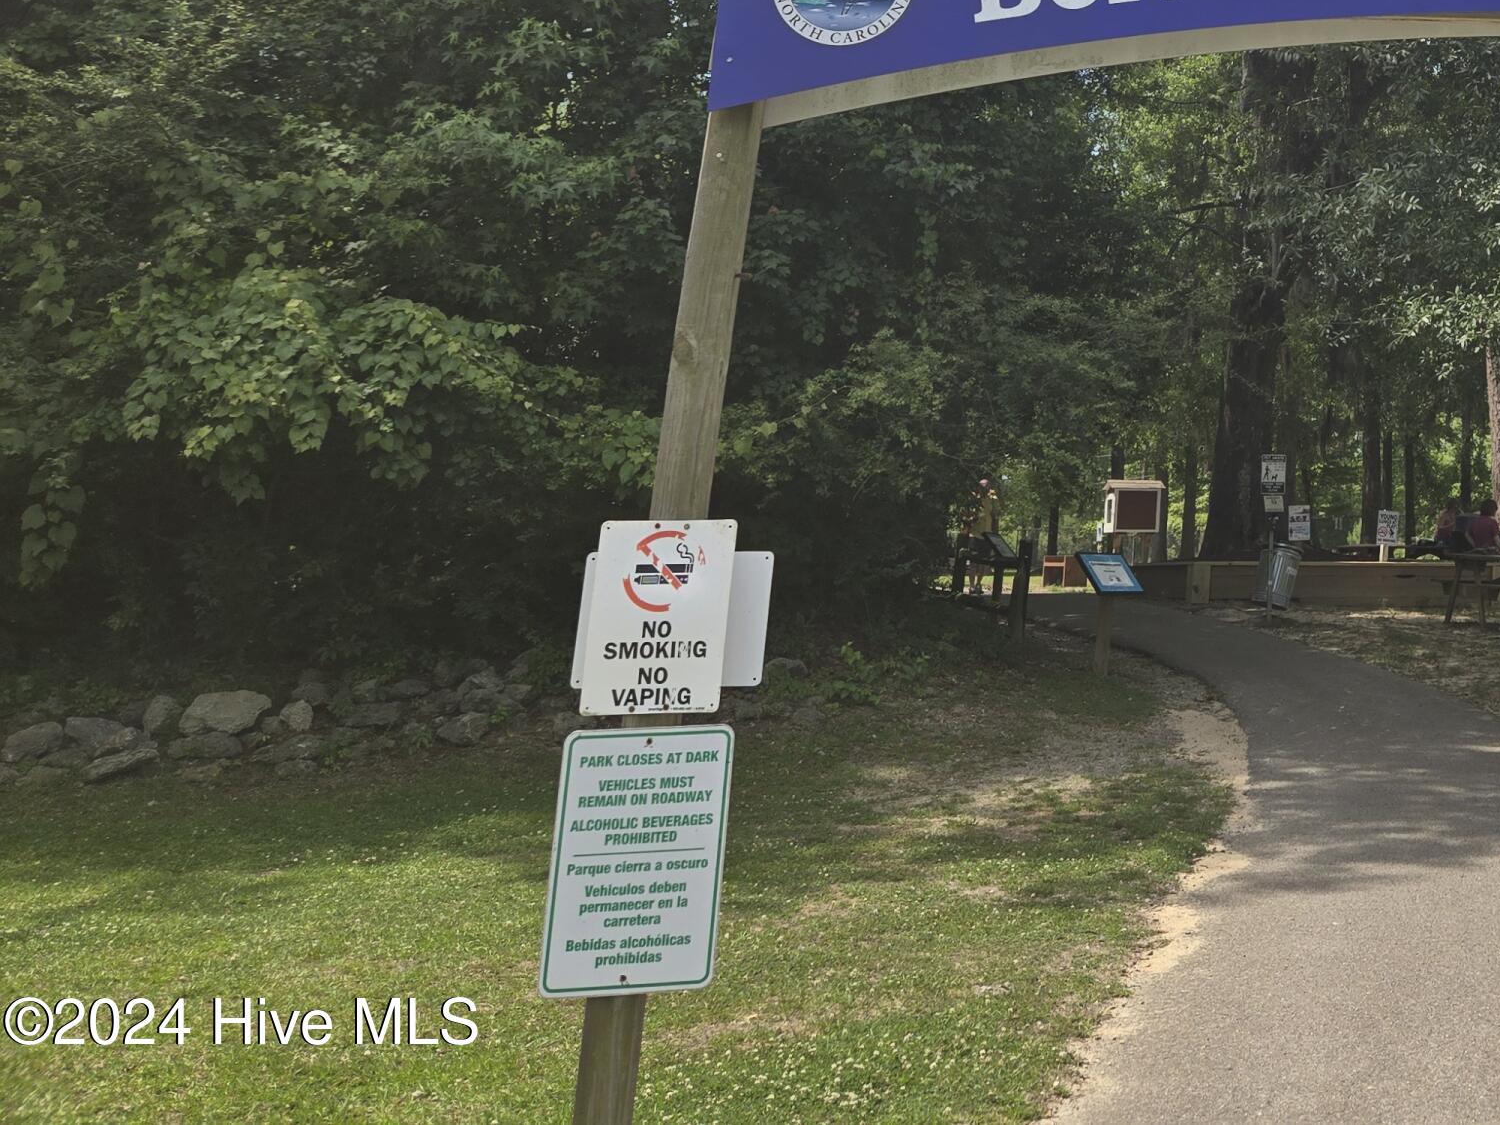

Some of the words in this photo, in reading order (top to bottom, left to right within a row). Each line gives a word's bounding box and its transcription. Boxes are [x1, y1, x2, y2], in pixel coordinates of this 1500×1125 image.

[641, 621, 671, 638] NO
[603, 641, 707, 659] SMOKING
[638, 667, 668, 684] NO
[612, 687, 691, 706] VAPING
[580, 755, 613, 767] PARK
[617, 754, 663, 766] CLOSES
[666, 752, 681, 764] AT
[685, 751, 719, 763] DARK
[598, 778, 656, 792] VEHICLES
[660, 776, 694, 788] MUST
[578, 795, 627, 808] REMAIN
[631, 794, 647, 805] ON
[651, 791, 713, 804] ROADWAY
[570, 818, 638, 832] ALCOHOLIC
[642, 814, 713, 829] BEVERAGES
[604, 831, 677, 846] PROHIBITED
[567, 862, 611, 877] Parque
[615, 861, 651, 874] cierra
[655, 862, 663, 871] a
[667, 858, 708, 870] oscuro
[649, 881, 687, 894] deben
[579, 899, 654, 915] permanecer
[658, 899, 673, 909] en
[676, 896, 688, 908] la
[603, 914, 661, 928] carretera
[566, 938, 616, 953] Bebidas
[620, 933, 691, 949] alcohólicas
[595, 951, 662, 968] prohibidas
